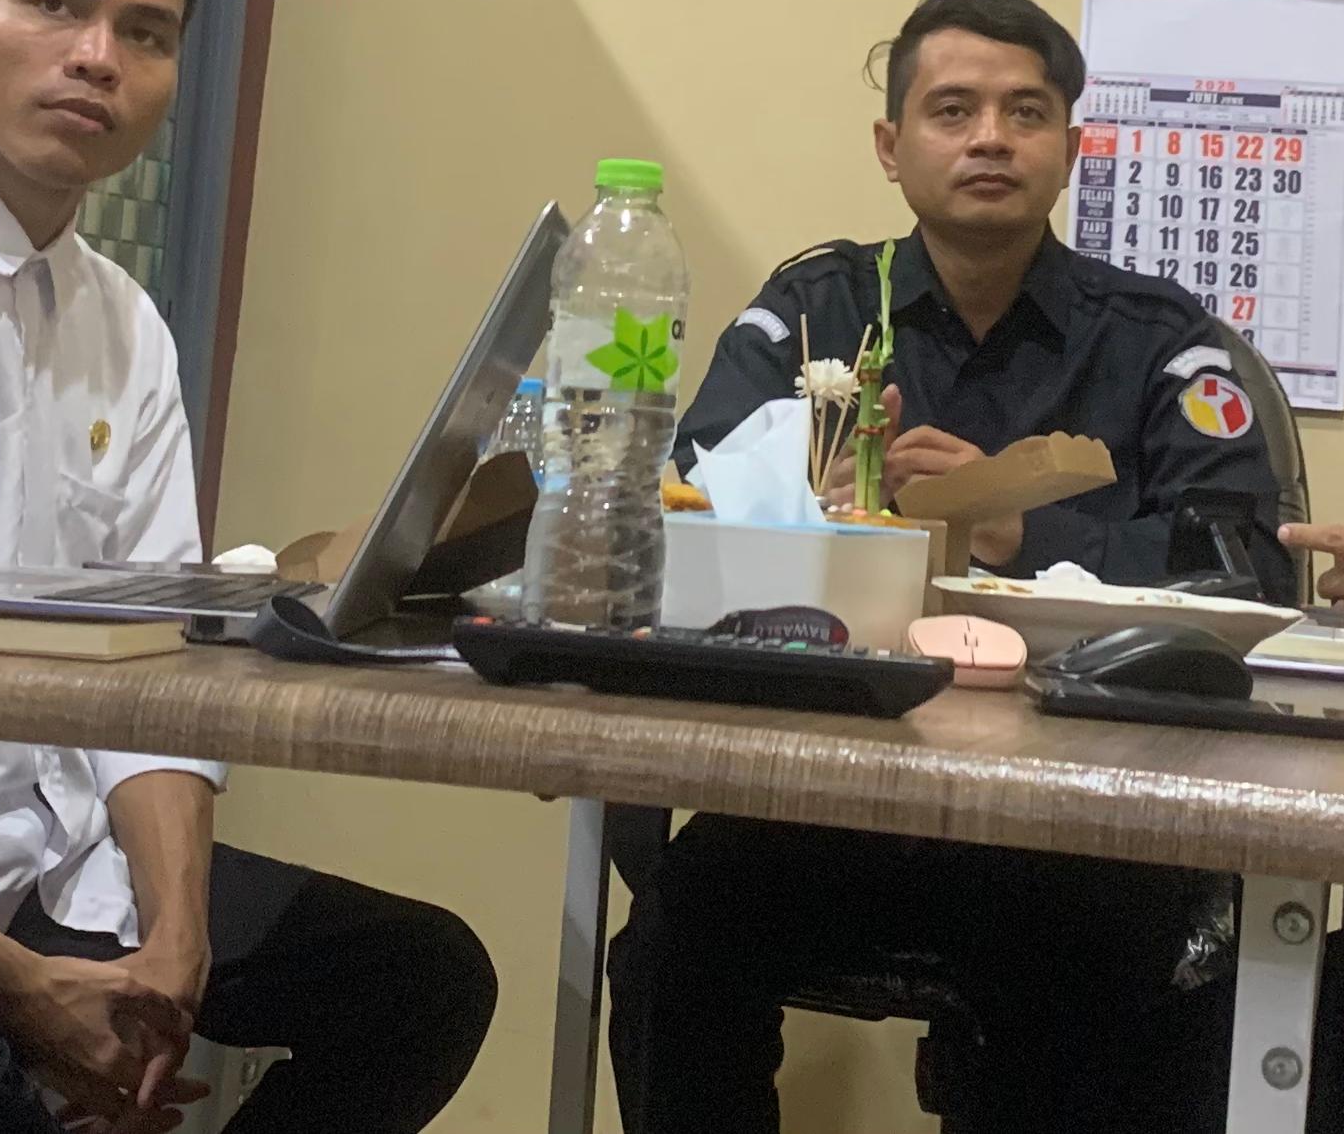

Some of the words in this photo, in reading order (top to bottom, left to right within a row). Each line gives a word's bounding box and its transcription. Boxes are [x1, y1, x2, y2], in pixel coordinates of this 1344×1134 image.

[1132, 130, 1142, 154] 1
[1167, 131, 1181, 155] 8
[1200, 134, 1224, 158] 15
[1236, 135, 1264, 160] 22
[1274, 137, 1302, 162] 29
[1128, 160, 1142, 184] 2
[1166, 162, 1180, 187] 9
[1199, 165, 1223, 190] 16
[1234, 167, 1263, 192] 23
[1272, 169, 1302, 194] 30
[1126, 192, 1140, 216] 3
[1159, 194, 1183, 219] 10
[1199, 197, 1220, 221] 17
[1233, 199, 1261, 224] 24
[1124, 224, 1138, 248] 4
[1159, 226, 1180, 251] 11
[1195, 229, 1220, 254] 18
[1231, 231, 1260, 256] 25
[1156, 258, 1180, 283] 12
[1193, 260, 1218, 286] 19
[1229, 263, 1257, 288] 26
[1232, 295, 1257, 321] 27
